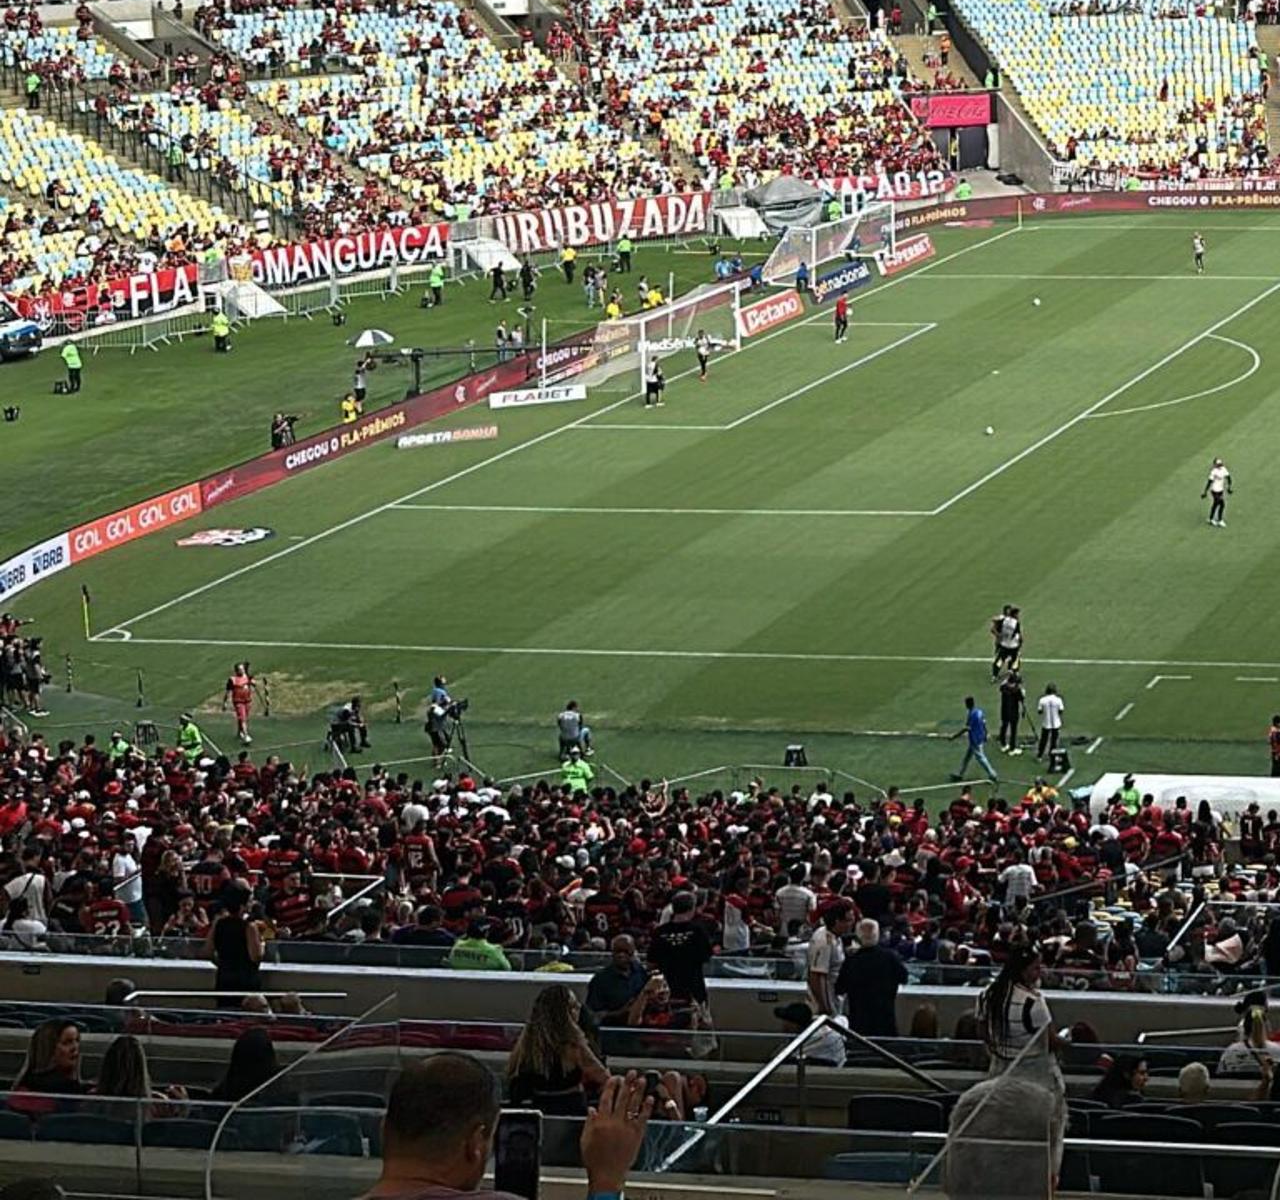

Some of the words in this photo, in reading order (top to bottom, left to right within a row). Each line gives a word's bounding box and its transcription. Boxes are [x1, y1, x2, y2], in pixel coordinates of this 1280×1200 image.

[920, 171, 946, 196] 12
[496, 194, 706, 253] URUBUZADA
[264, 226, 444, 283] MANGUAÇA
[286, 440, 329, 470] CHEGOU
[74, 528, 103, 554] GOL
[106, 514, 135, 540] GOL
[138, 503, 167, 529] GOL
[170, 491, 198, 516] GOL
[42, 546, 64, 571] BRB
